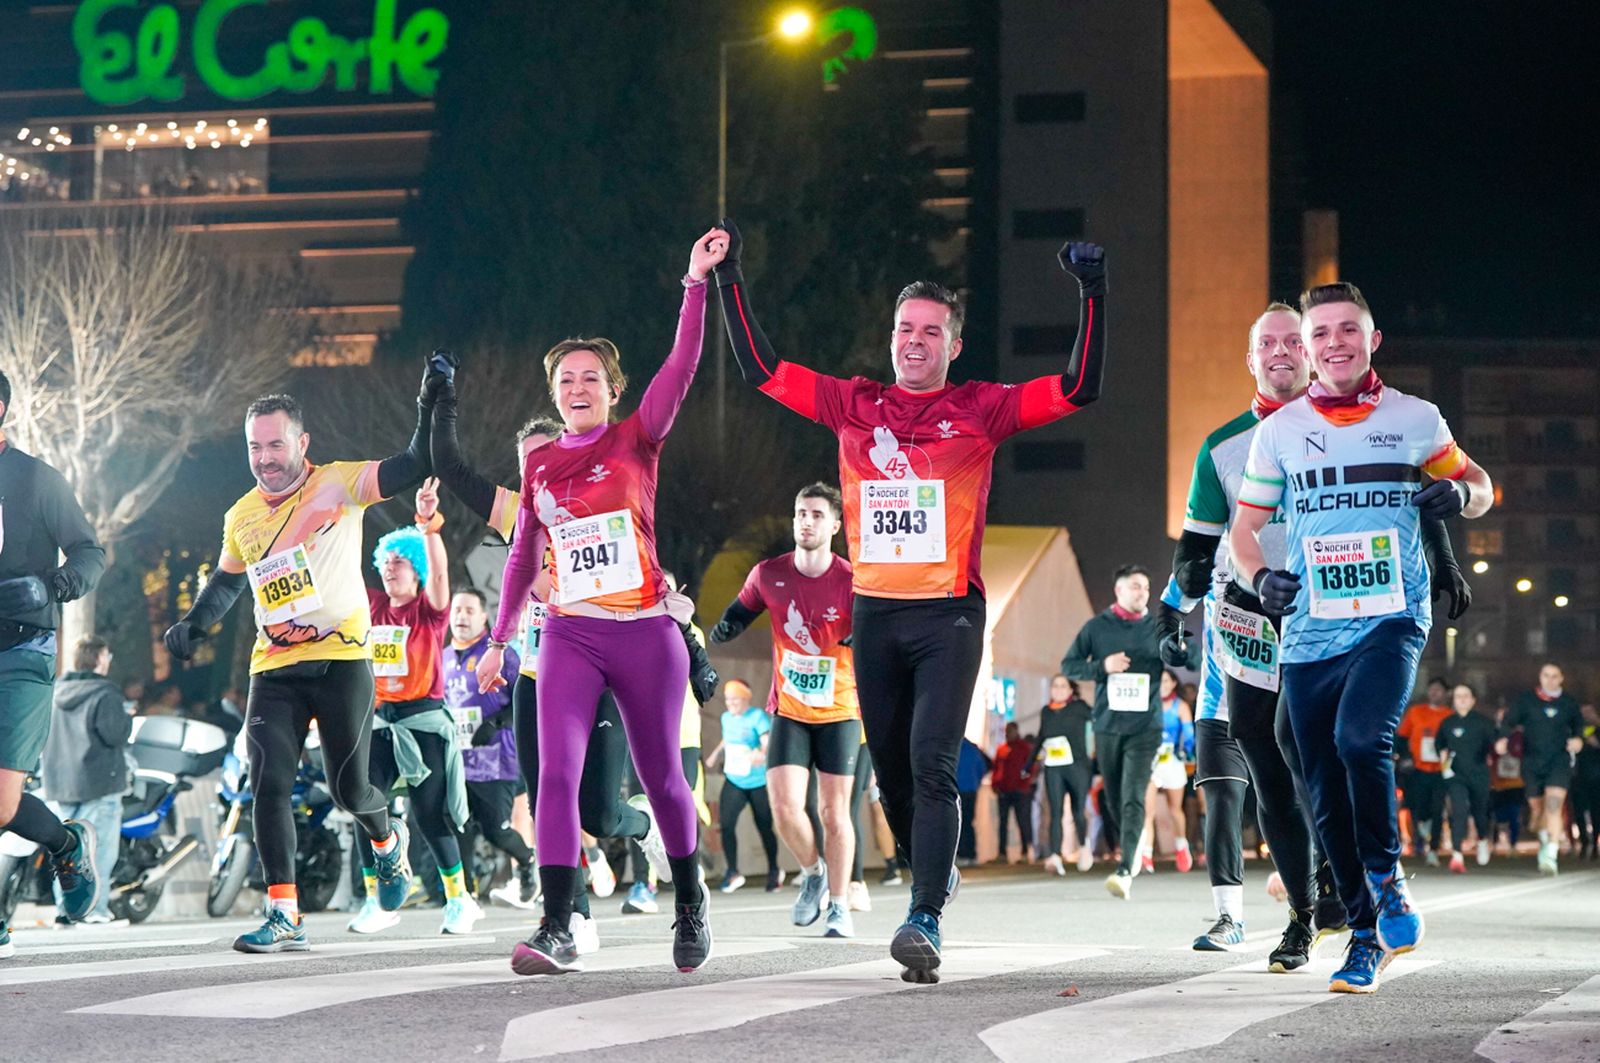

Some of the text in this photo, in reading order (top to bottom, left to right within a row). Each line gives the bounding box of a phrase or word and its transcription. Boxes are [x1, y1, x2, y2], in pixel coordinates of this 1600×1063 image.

[72, 0, 449, 104] El Corte
[1305, 431, 1326, 456] Ñ
[885, 457, 908, 479] 43
[876, 489, 899, 498] NOCHE
[899, 489, 909, 498] DE
[1296, 490, 1418, 514] ALCAUDET
[868, 499, 882, 509] SAN
[873, 510, 927, 535] 3343
[562, 540, 575, 551] SAN
[1324, 543, 1350, 553] NOCHE
[1352, 542, 1363, 551] DE
[570, 541, 619, 573] 2947
[1316, 555, 1332, 564] SAN
[1334, 552, 1365, 563] ANTÓN
[1317, 560, 1391, 590] 13856
[262, 568, 314, 604] 13934
[1218, 619, 1233, 630] SAN
[1230, 614, 1257, 628] NOCHE DE
[795, 630, 808, 645] 43
[788, 669, 827, 689] 12937
